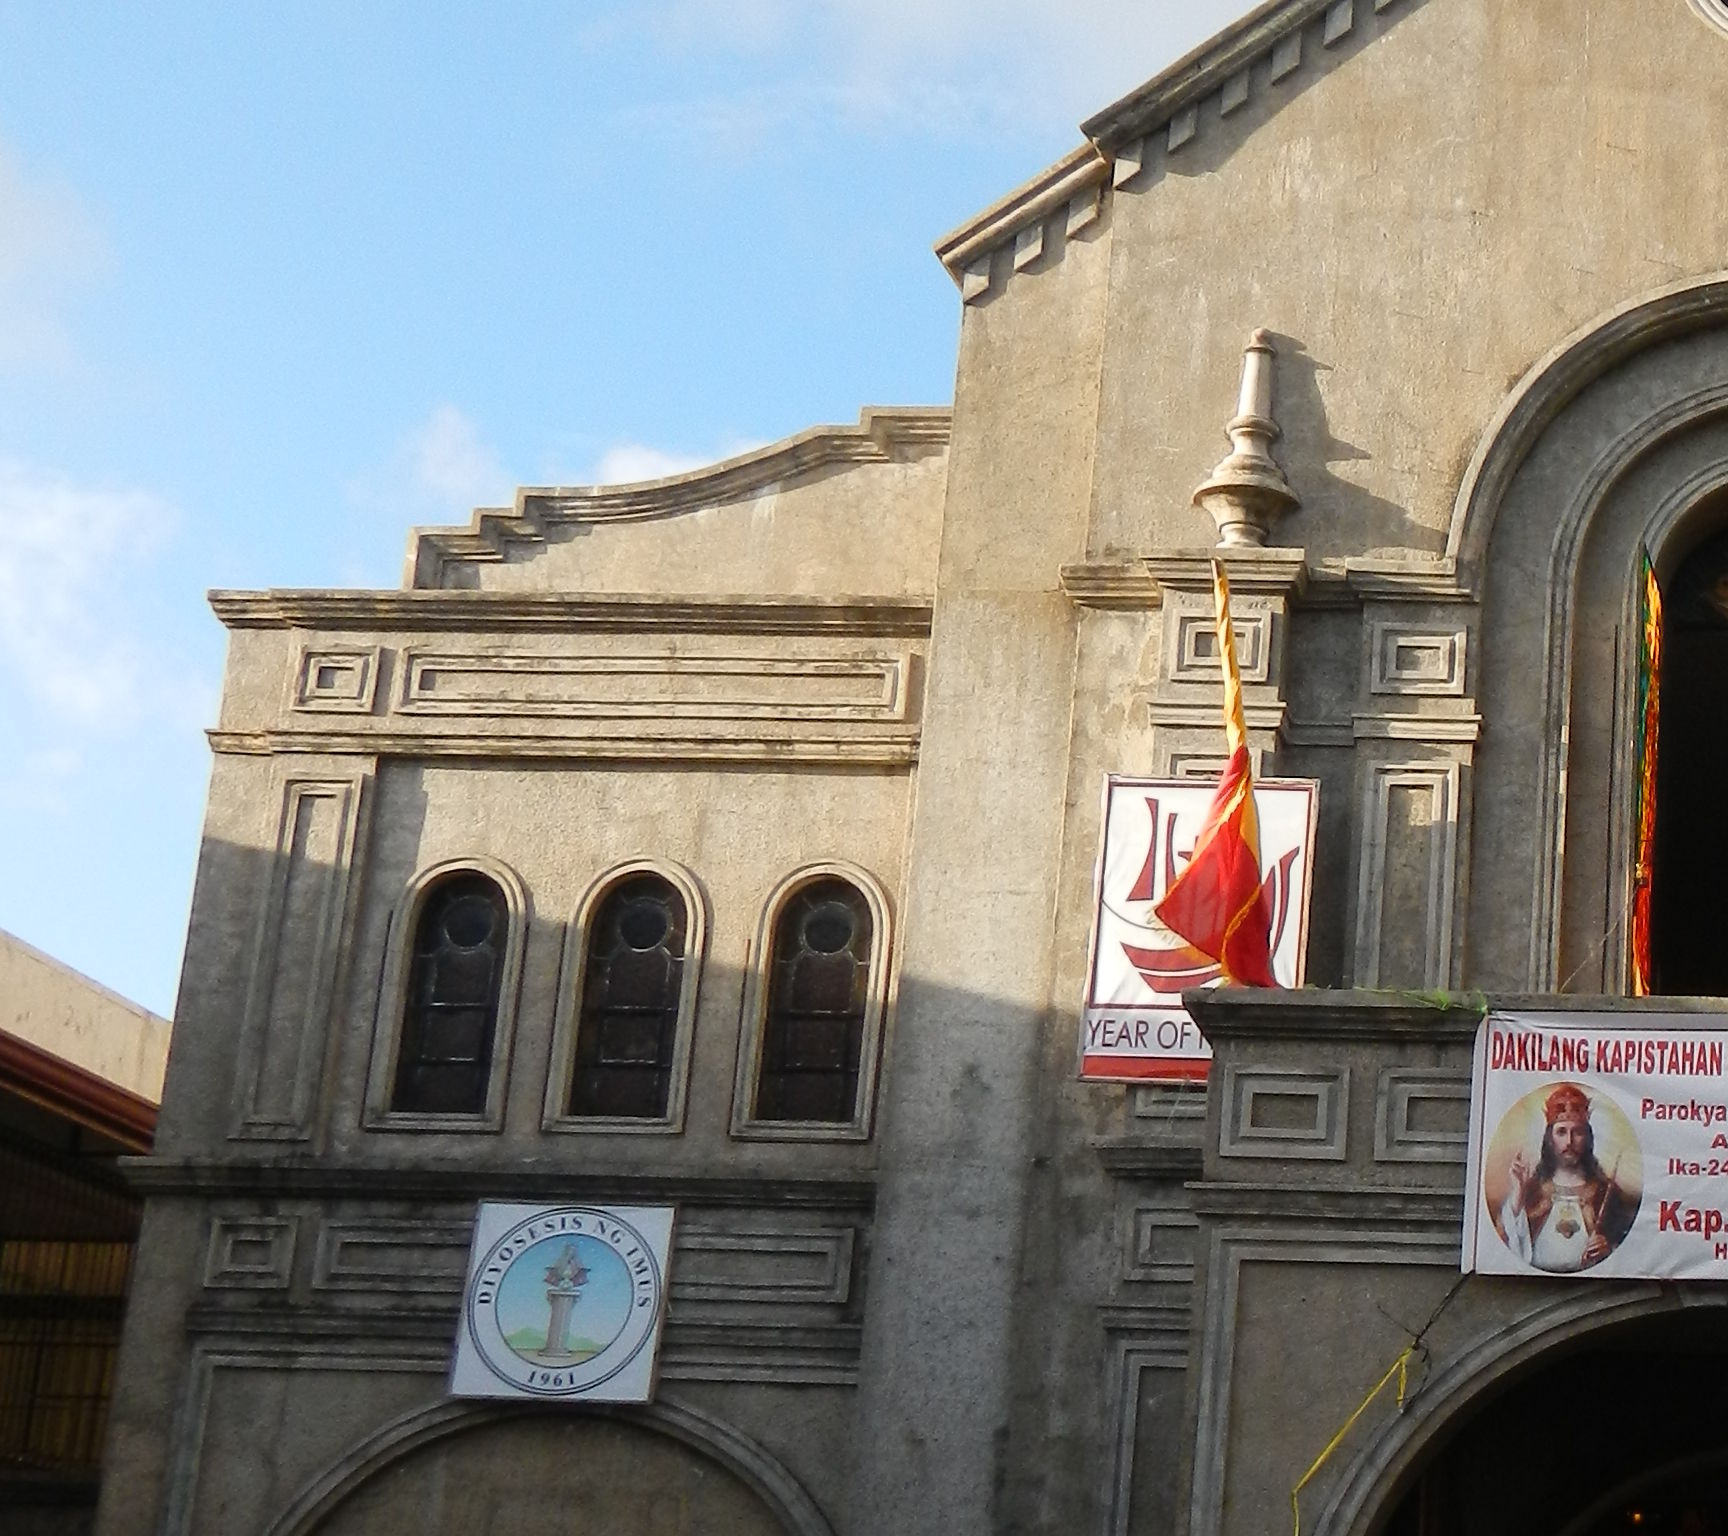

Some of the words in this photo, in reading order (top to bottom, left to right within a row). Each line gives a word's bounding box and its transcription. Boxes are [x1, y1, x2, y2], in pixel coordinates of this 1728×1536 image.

[1088, 1019, 1149, 1049] YEAR
[1157, 1020, 1192, 1050] OF
[1491, 1031, 1589, 1073] DAKILANG
[1597, 1039, 1723, 1076] KAPISTAHAN
[1641, 1098, 1727, 1127] Parokya
[477, 1216, 584, 1306] DIYOSESIS
[593, 1220, 625, 1245] NG
[626, 1247, 651, 1308] IMUS
[527, 1370, 575, 1387] 1961
